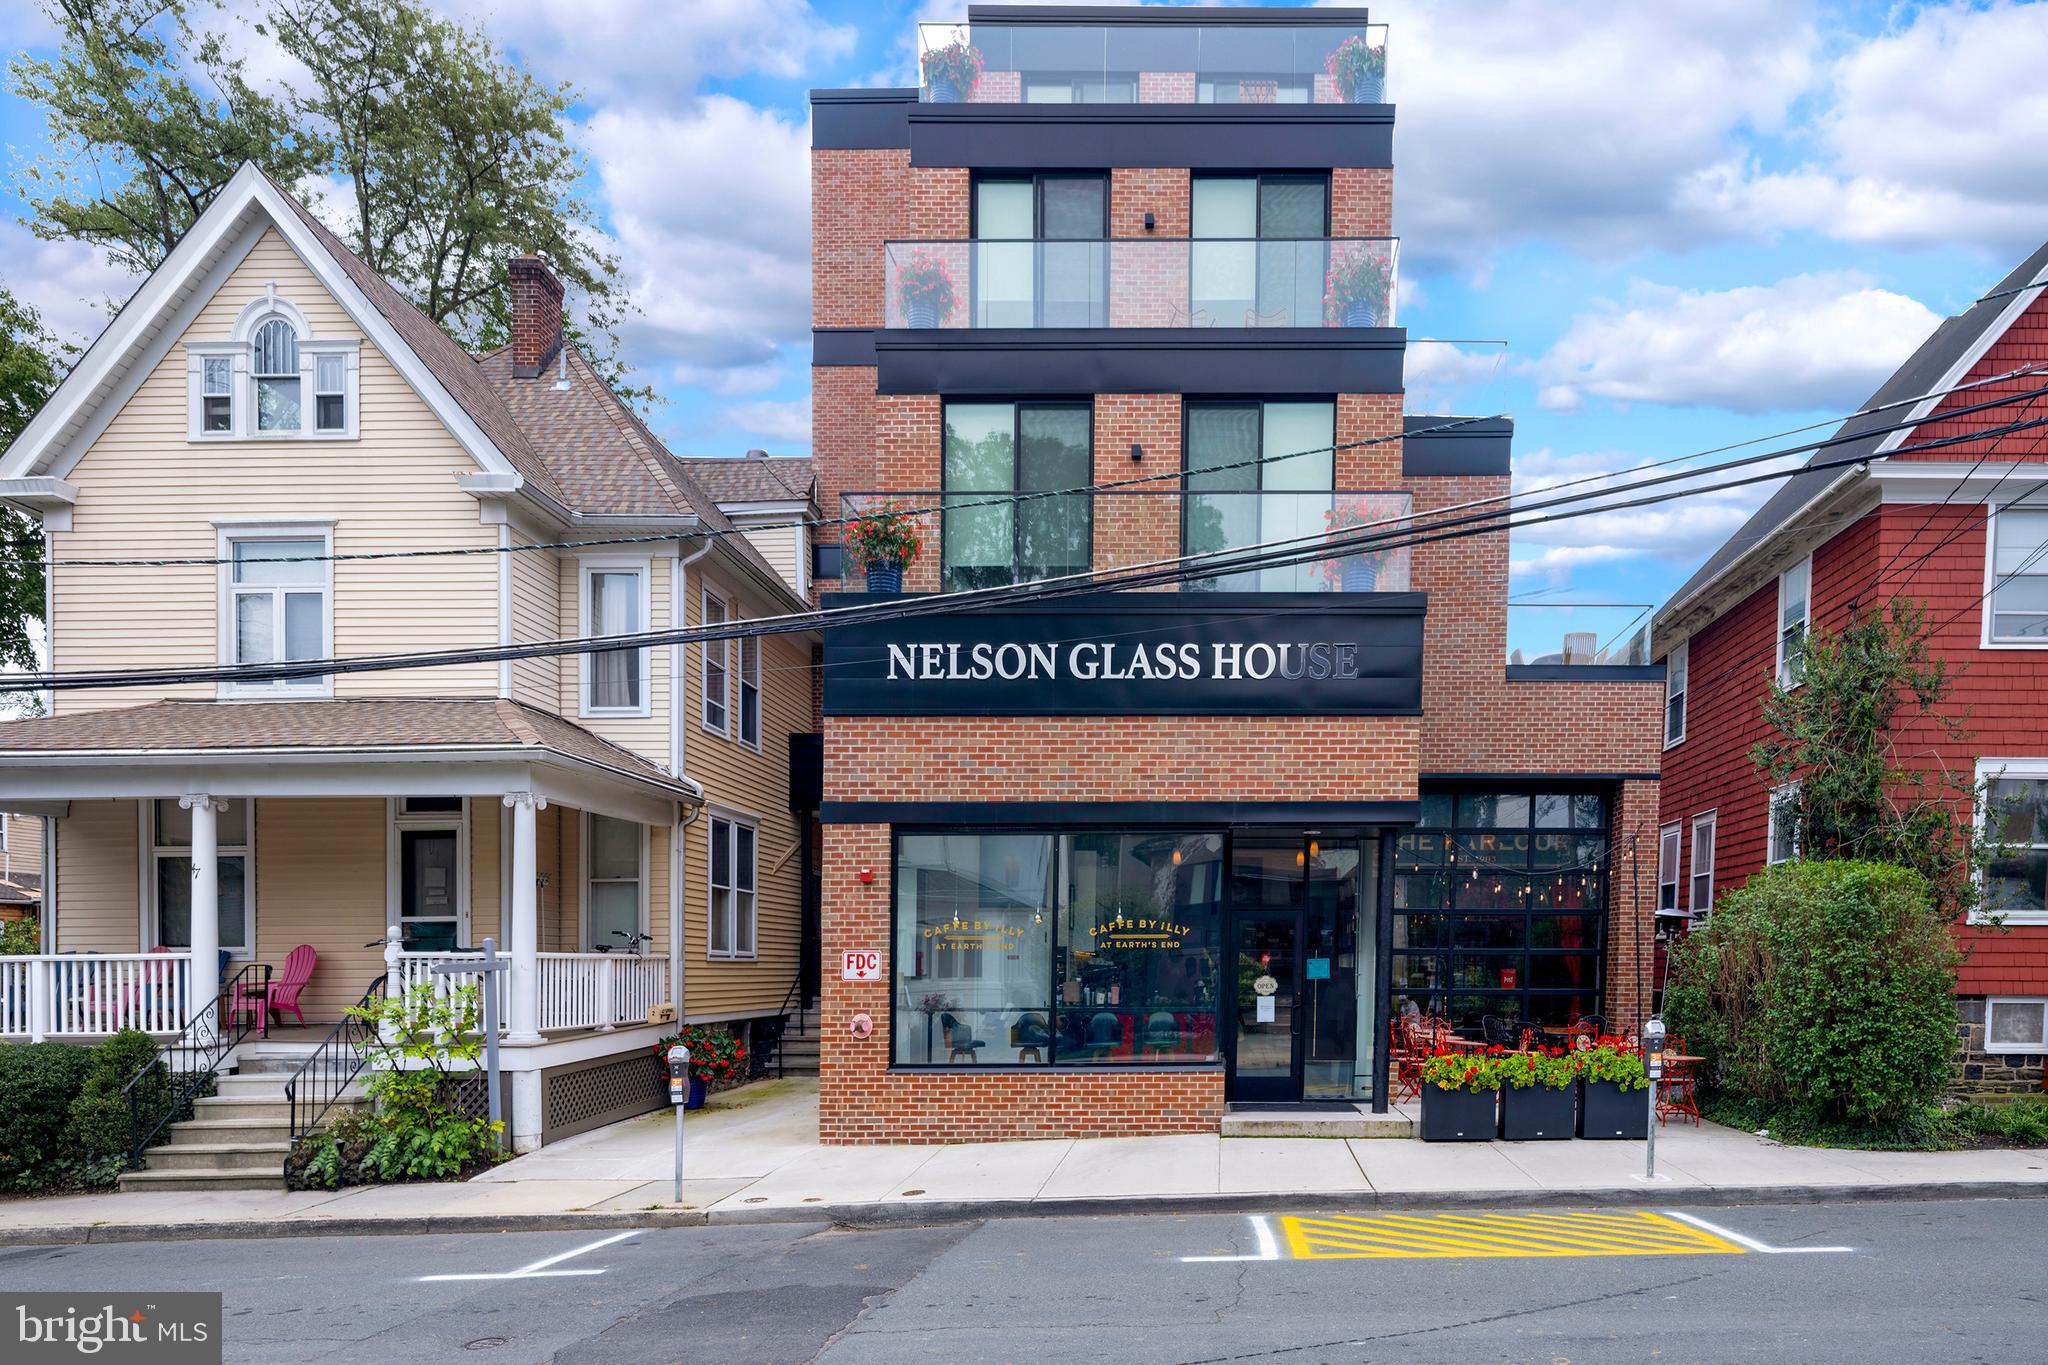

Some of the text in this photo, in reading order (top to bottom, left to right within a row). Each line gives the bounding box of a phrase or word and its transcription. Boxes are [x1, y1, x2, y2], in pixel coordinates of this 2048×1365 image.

[887, 643, 1359, 680] NELSON GLASS HOUSE
[1399, 834, 1434, 850] HE
[974, 920, 991, 930] BY
[1139, 919, 1157, 929] BY
[1100, 941, 1180, 949] AT EARTH'S END
[846, 953, 877, 970] FDC
